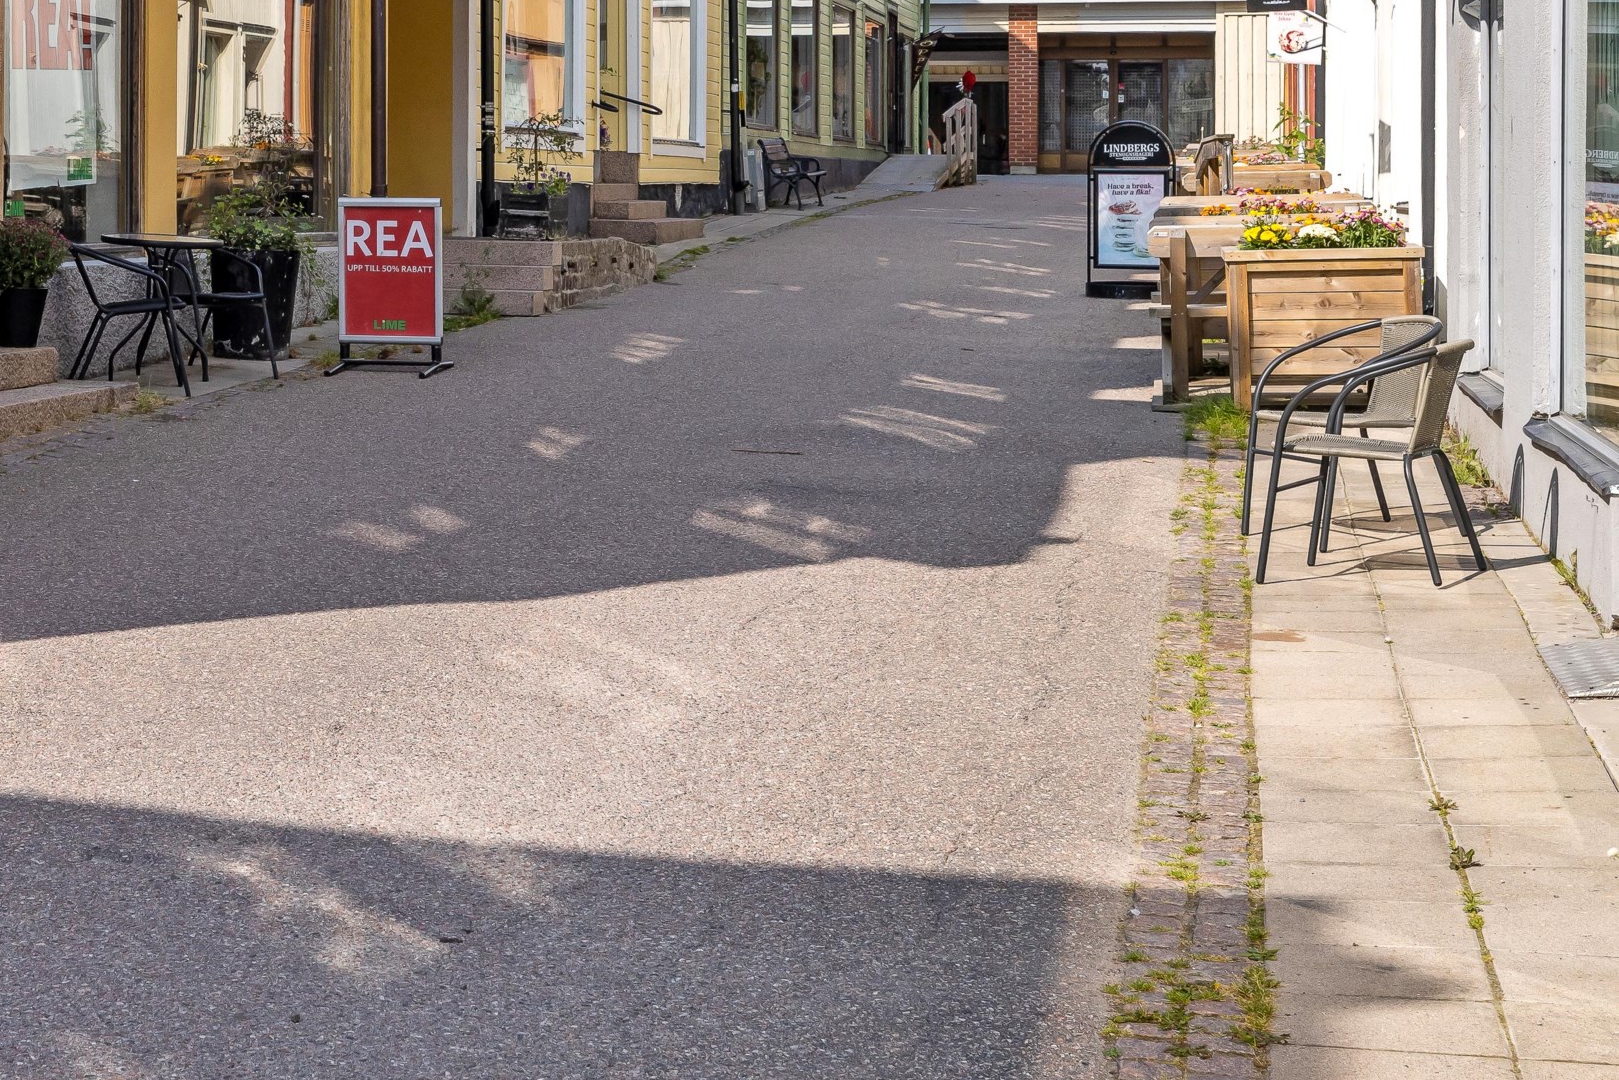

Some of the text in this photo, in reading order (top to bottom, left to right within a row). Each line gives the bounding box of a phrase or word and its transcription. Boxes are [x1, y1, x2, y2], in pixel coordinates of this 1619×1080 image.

[1103, 143, 1160, 153] LINDBERGS
[346, 219, 434, 258] REA
[347, 264, 433, 273] UPP TILL 50% RABATT
